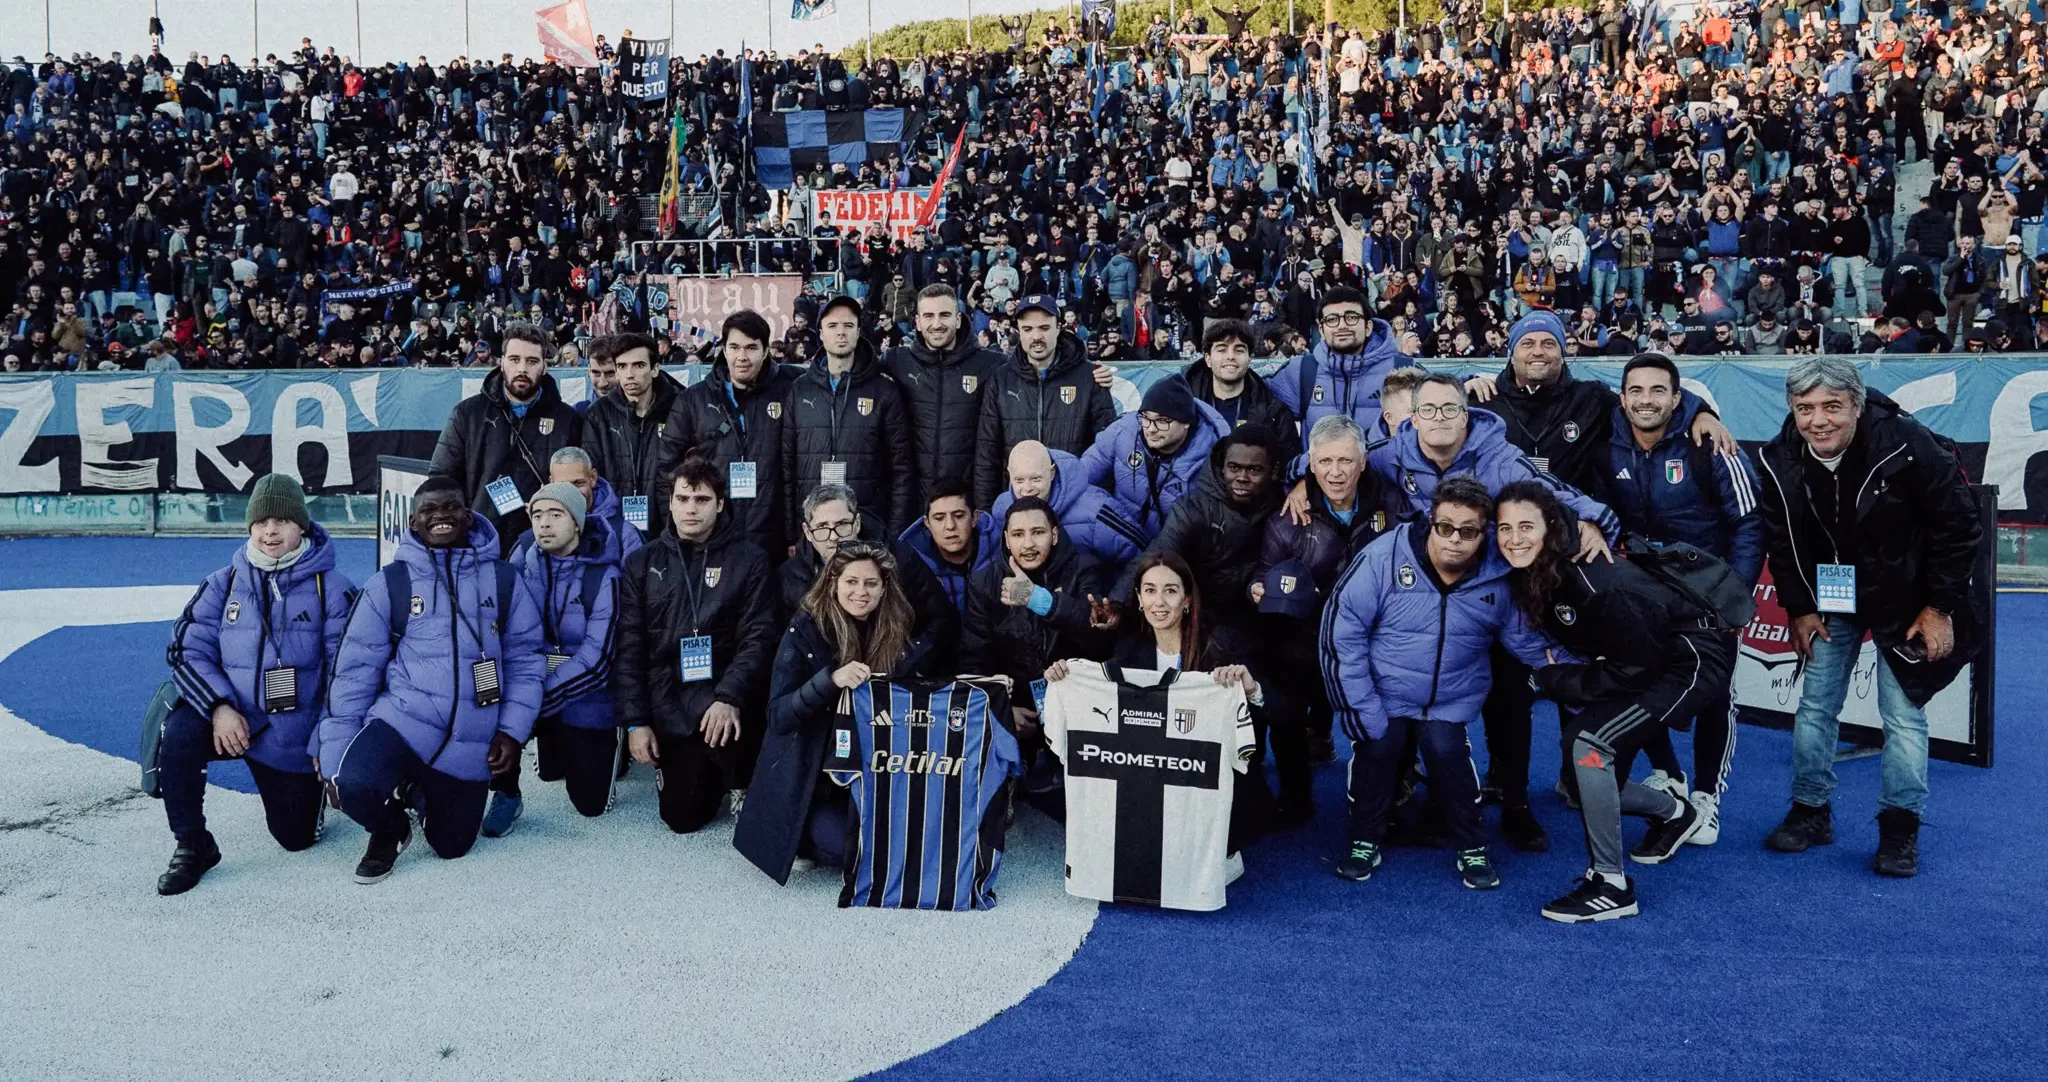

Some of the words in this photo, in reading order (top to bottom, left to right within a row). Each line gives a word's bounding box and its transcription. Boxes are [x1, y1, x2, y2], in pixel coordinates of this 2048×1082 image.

[630, 40, 665, 57] VIVO
[632, 61, 659, 77] PER
[621, 80, 666, 98] QUESTO
[816, 191, 910, 221] FEDELI
[1900, 203, 1906, 212] 5
[732, 463, 746, 472] PISA
[488, 480, 504, 493] PISA
[503, 476, 512, 486] SC
[624, 497, 638, 506] PISA
[638, 496, 647, 506] SC
[1819, 566, 1841, 578] PISA
[1841, 567, 1853, 578] SC
[682, 638, 700, 649] PISA
[700, 637, 710, 648] SC
[1032, 681, 1047, 692] PIS
[1121, 709, 1165, 720] ADMIRAL
[870, 750, 966, 776] Cetilar
[1077, 744, 1207, 774] PROMETEON
